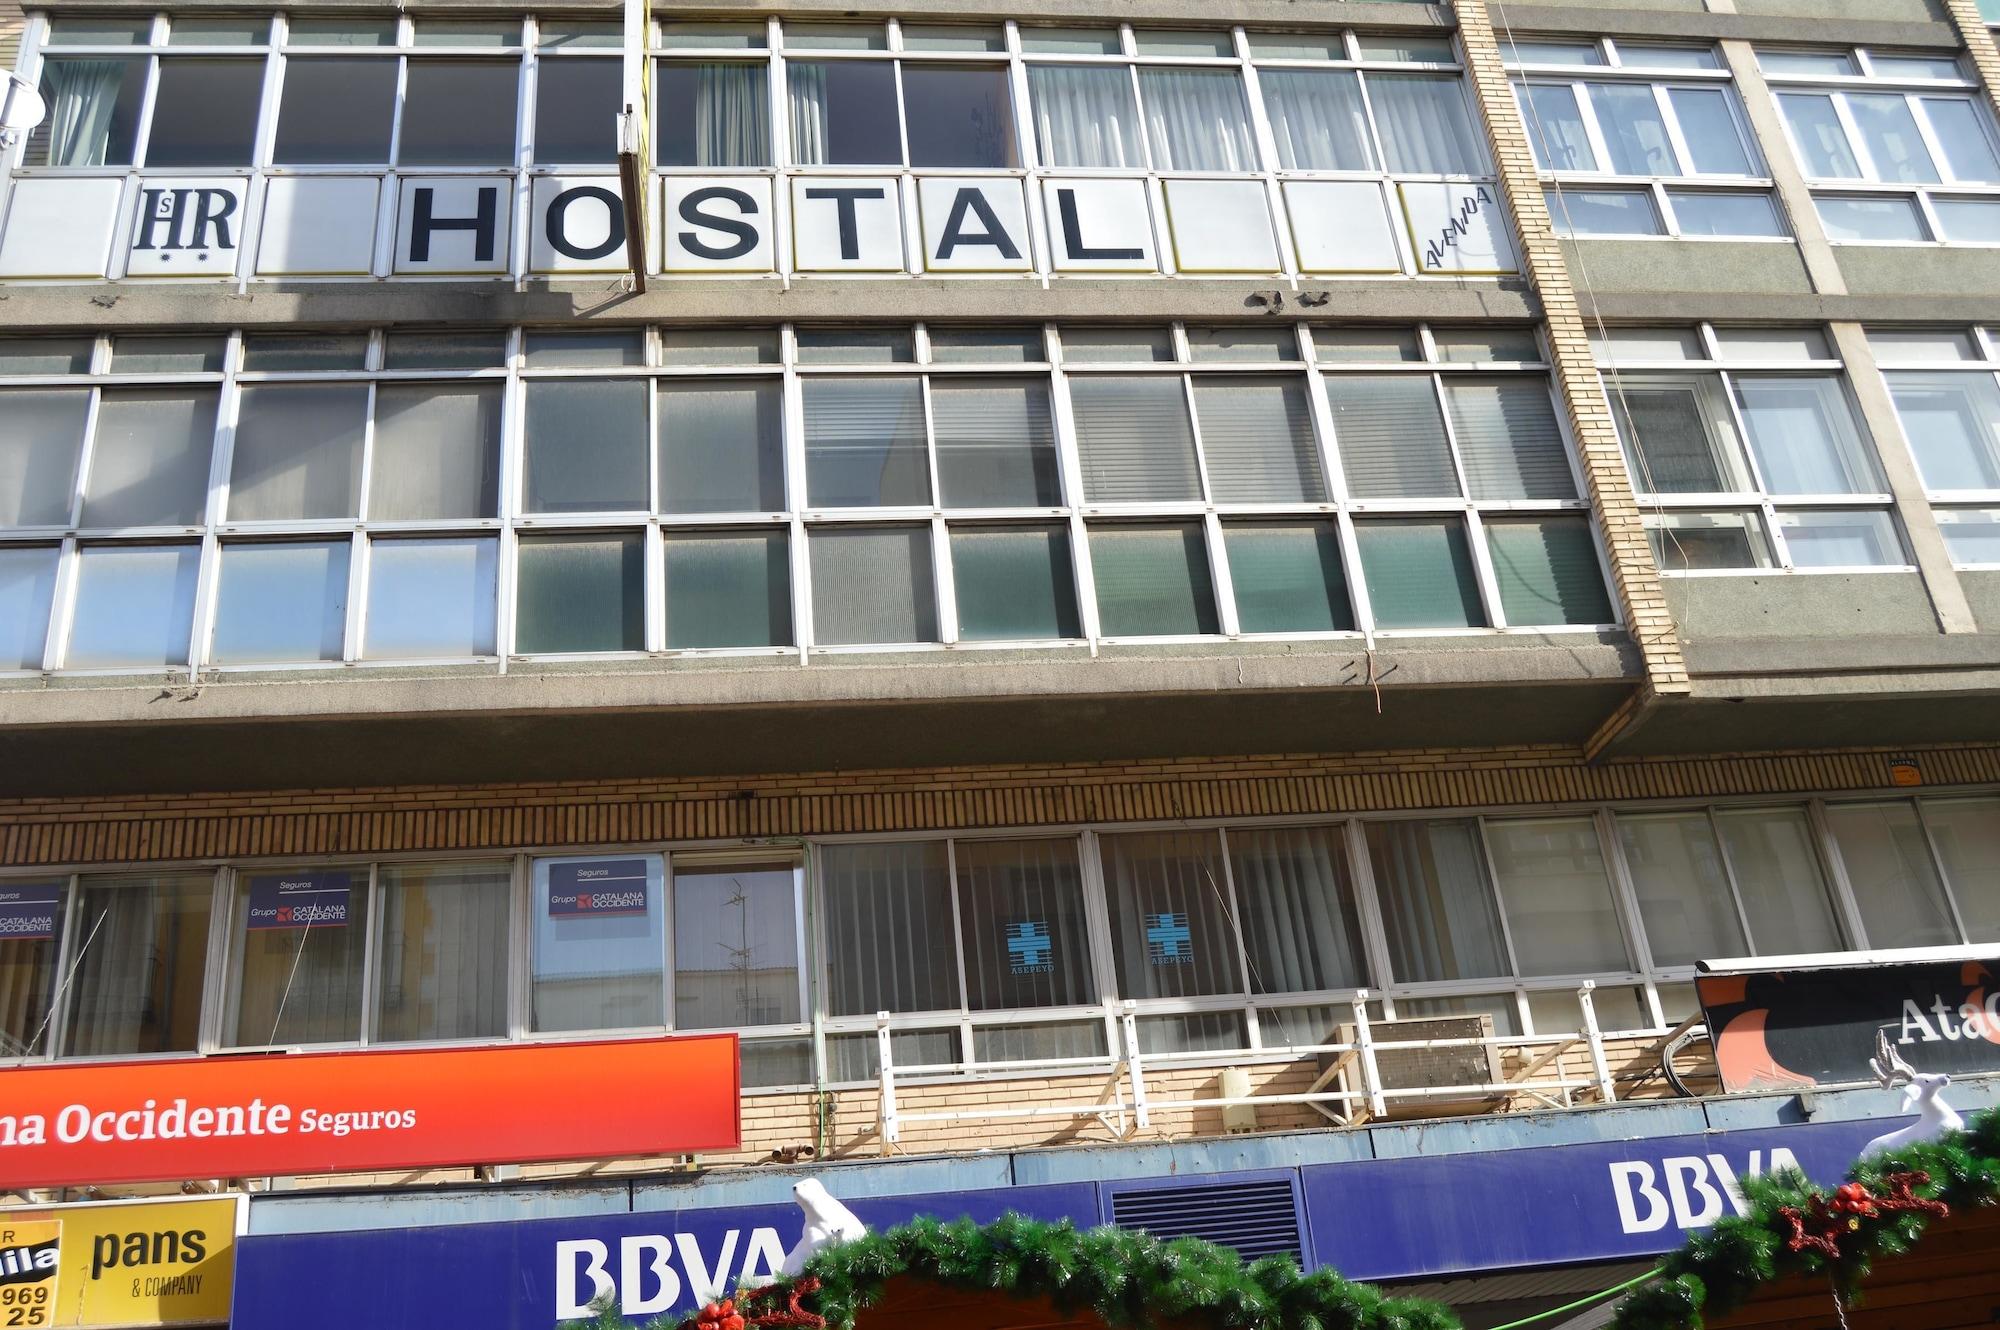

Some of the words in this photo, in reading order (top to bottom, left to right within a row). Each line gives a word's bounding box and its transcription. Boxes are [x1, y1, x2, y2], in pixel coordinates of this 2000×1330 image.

[409, 186, 1144, 262] HOSTAL
[1426, 186, 1492, 268] AVENIDA
[577, 869, 609, 878] Seguros
[279, 881, 312, 891] Seguros
[551, 896, 577, 905] Grupo
[592, 891, 644, 901] CATALANA
[592, 899, 644, 908] OCCIDENTE
[251, 908, 277, 917] Grupo
[293, 904, 346, 914] CATALANA
[0, 916, 52, 926] CATALANA
[293, 911, 346, 921] OCCIDENTE
[0, 923, 52, 933] OCCIDENTE
[1011, 965, 1055, 975] ASEPEYO
[56, 1098, 291, 1144] Occidente
[299, 1109, 417, 1137] Seguros
[92, 1229, 207, 1280] pans
[556, 1227, 787, 1320] BBVA
[132, 1278, 141, 1298] &
[145, 1275, 203, 1297] COMPANY
[2, 1286, 48, 1306] 969
[6, 1306, 46, 1326] 25
